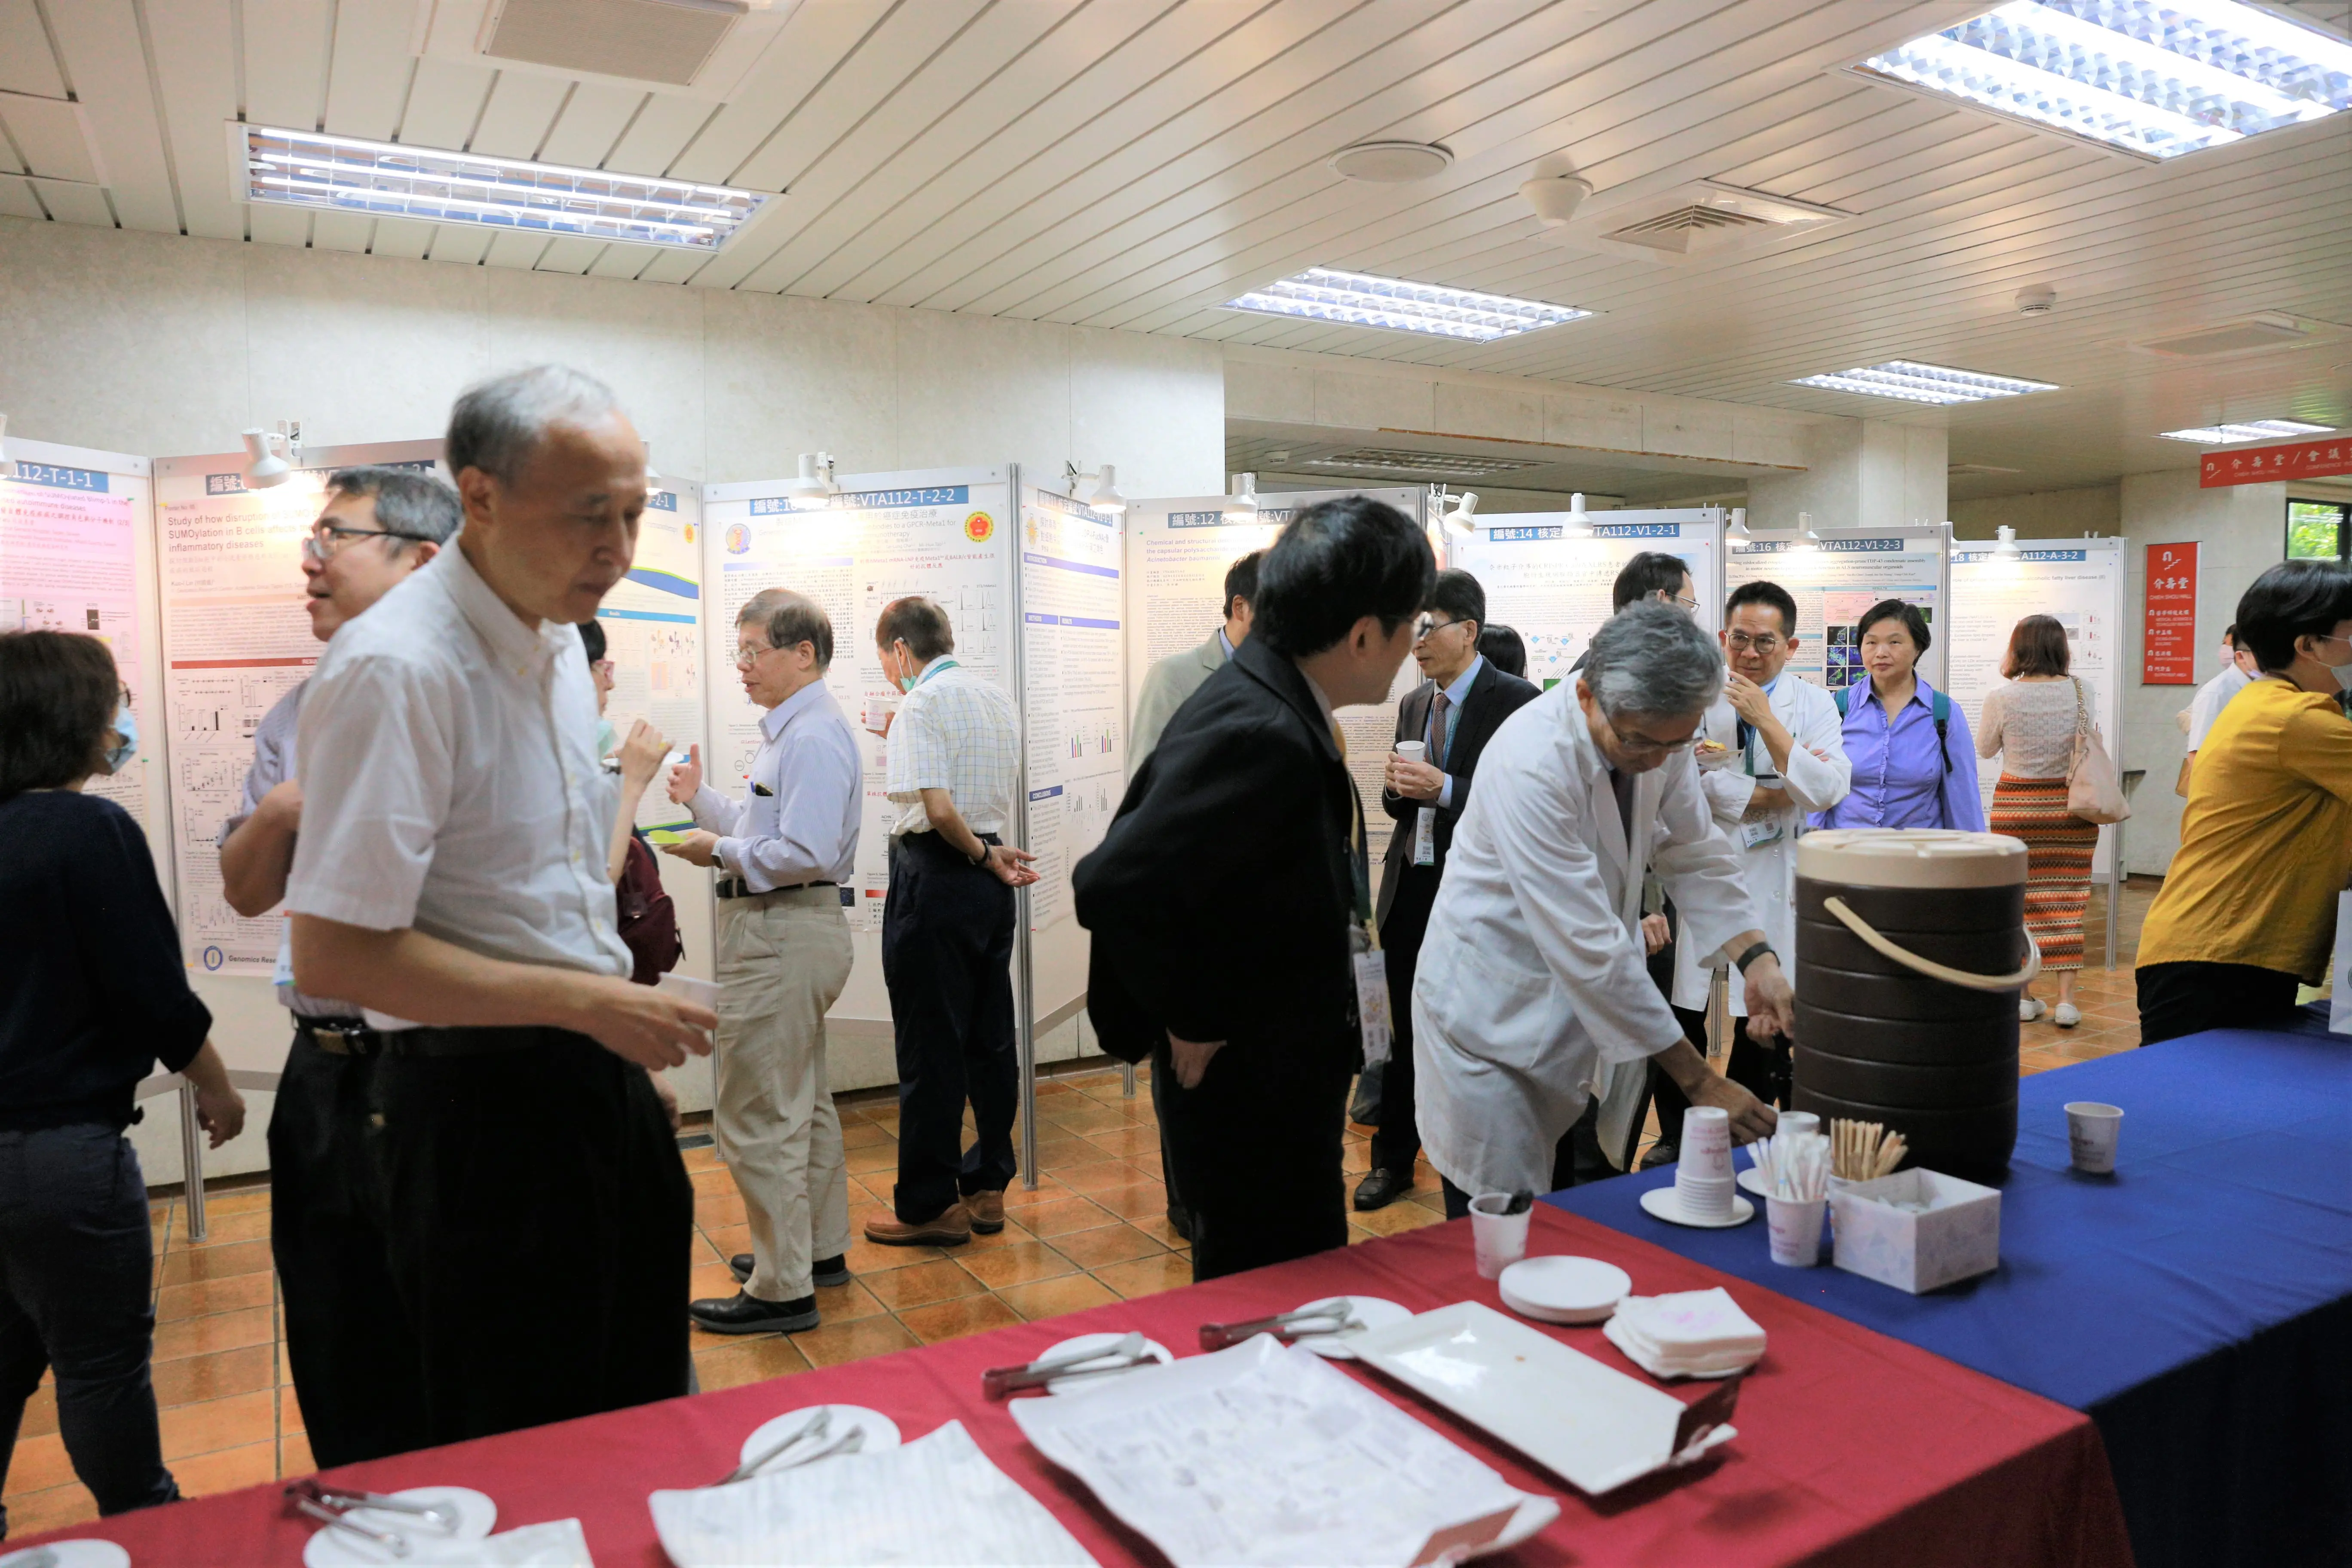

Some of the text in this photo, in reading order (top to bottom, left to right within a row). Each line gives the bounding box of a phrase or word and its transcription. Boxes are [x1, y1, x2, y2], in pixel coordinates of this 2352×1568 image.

[2231, 447, 2352, 469] 介壽堂/會議
[13, 463, 93, 487] 112-T-1-1
[827, 488, 954, 509] 編號:VTA112-T-2-2
[168, 517, 192, 527] Study
[195, 516, 203, 524] of
[205, 514, 223, 524] how
[226, 512, 271, 524] disruption
[906, 520, 946, 528] GPCR-Meta1
[1172, 513, 1215, 526] 編號:12
[168, 527, 224, 540] SUMOylation
[236, 527, 242, 535] B
[245, 526, 265, 535] cells
[1493, 524, 1676, 540] 編號:14 核定TA112-V1-2-1
[169, 540, 264, 553] inflammatory diseases
[1184, 546, 1229, 554] polysaccharide
[1775, 540, 1901, 552] 核定VTA112-V1-2-3
[1968, 551, 2078, 562] 核定A112-A-3-2
[2153, 577, 2189, 589] 介壽堂
[1032, 789, 1051, 800] CONCLUSIONS
